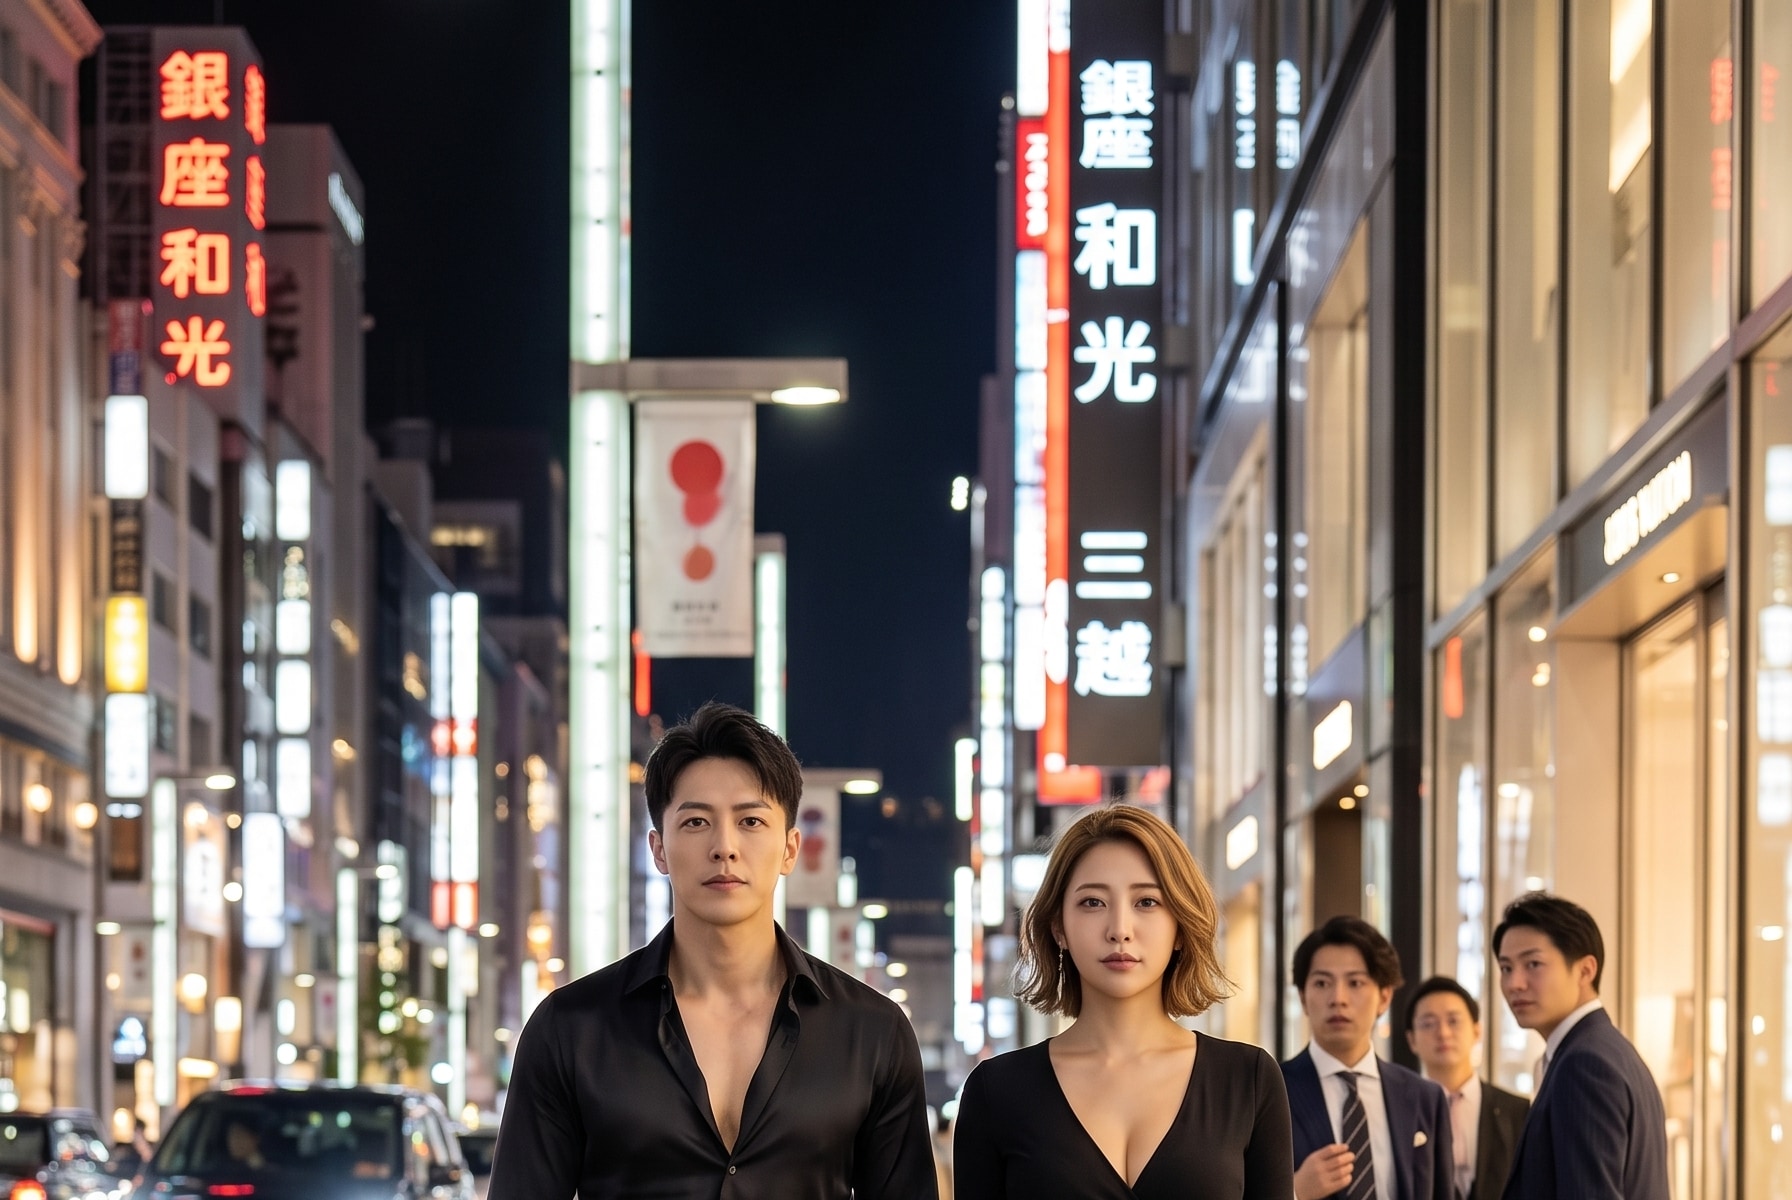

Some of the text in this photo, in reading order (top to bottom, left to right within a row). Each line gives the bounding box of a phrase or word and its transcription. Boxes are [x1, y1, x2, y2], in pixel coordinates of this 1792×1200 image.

[159, 50, 231, 388] 銀座和光
[1074, 59, 1157, 404] 銀座和光
[1074, 531, 1153, 697] 三越
